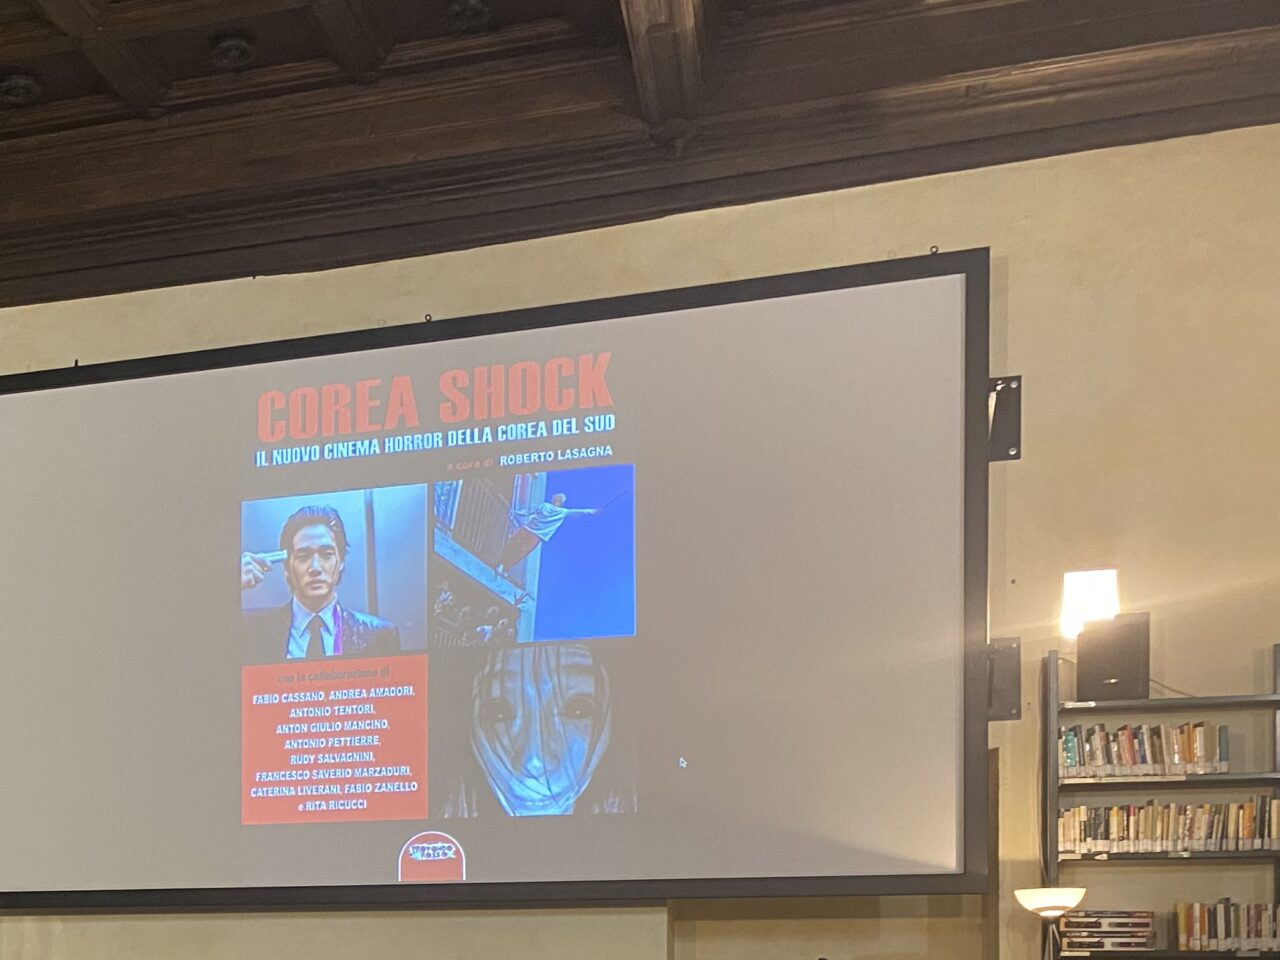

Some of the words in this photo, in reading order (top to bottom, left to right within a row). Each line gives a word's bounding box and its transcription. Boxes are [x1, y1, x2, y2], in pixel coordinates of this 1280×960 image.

[257, 376, 419, 443] COREA
[439, 352, 614, 423] SHOCK
[255, 451, 269, 468] IL
[272, 445, 320, 466] NUOVO
[324, 438, 380, 460] CINEMA
[385, 432, 443, 454] HORROR
[448, 427, 492, 447] DELLA
[498, 421, 547, 441] COREA
[553, 418, 580, 436] DEL
[584, 414, 615, 433] SUD
[499, 451, 554, 466] ROBERTO
[557, 445, 613, 460] LASAGNA
[252, 694, 280, 704] FABIO
[329, 688, 367, 700] ANDREA
[289, 706, 331, 718] ANTONIO
[333, 704, 376, 715] TENTORI,
[276, 722, 308, 734] ANTON
[310, 721, 342, 733] GIULIO
[344, 719, 390, 731] MANCINO,
[284, 738, 326, 750] ANTONIO
[290, 754, 315, 765] RUDY
[255, 770, 310, 781] FRANCESCO
[312, 768, 352, 780] SAVERIO
[250, 786, 295, 797] CATERINA
[344, 783, 372, 793] FABIO
[374, 781, 418, 792] ZANELLO
[298, 803, 303, 811] e
[306, 800, 327, 811] RITA
[329, 799, 367, 810] RICUCCI
